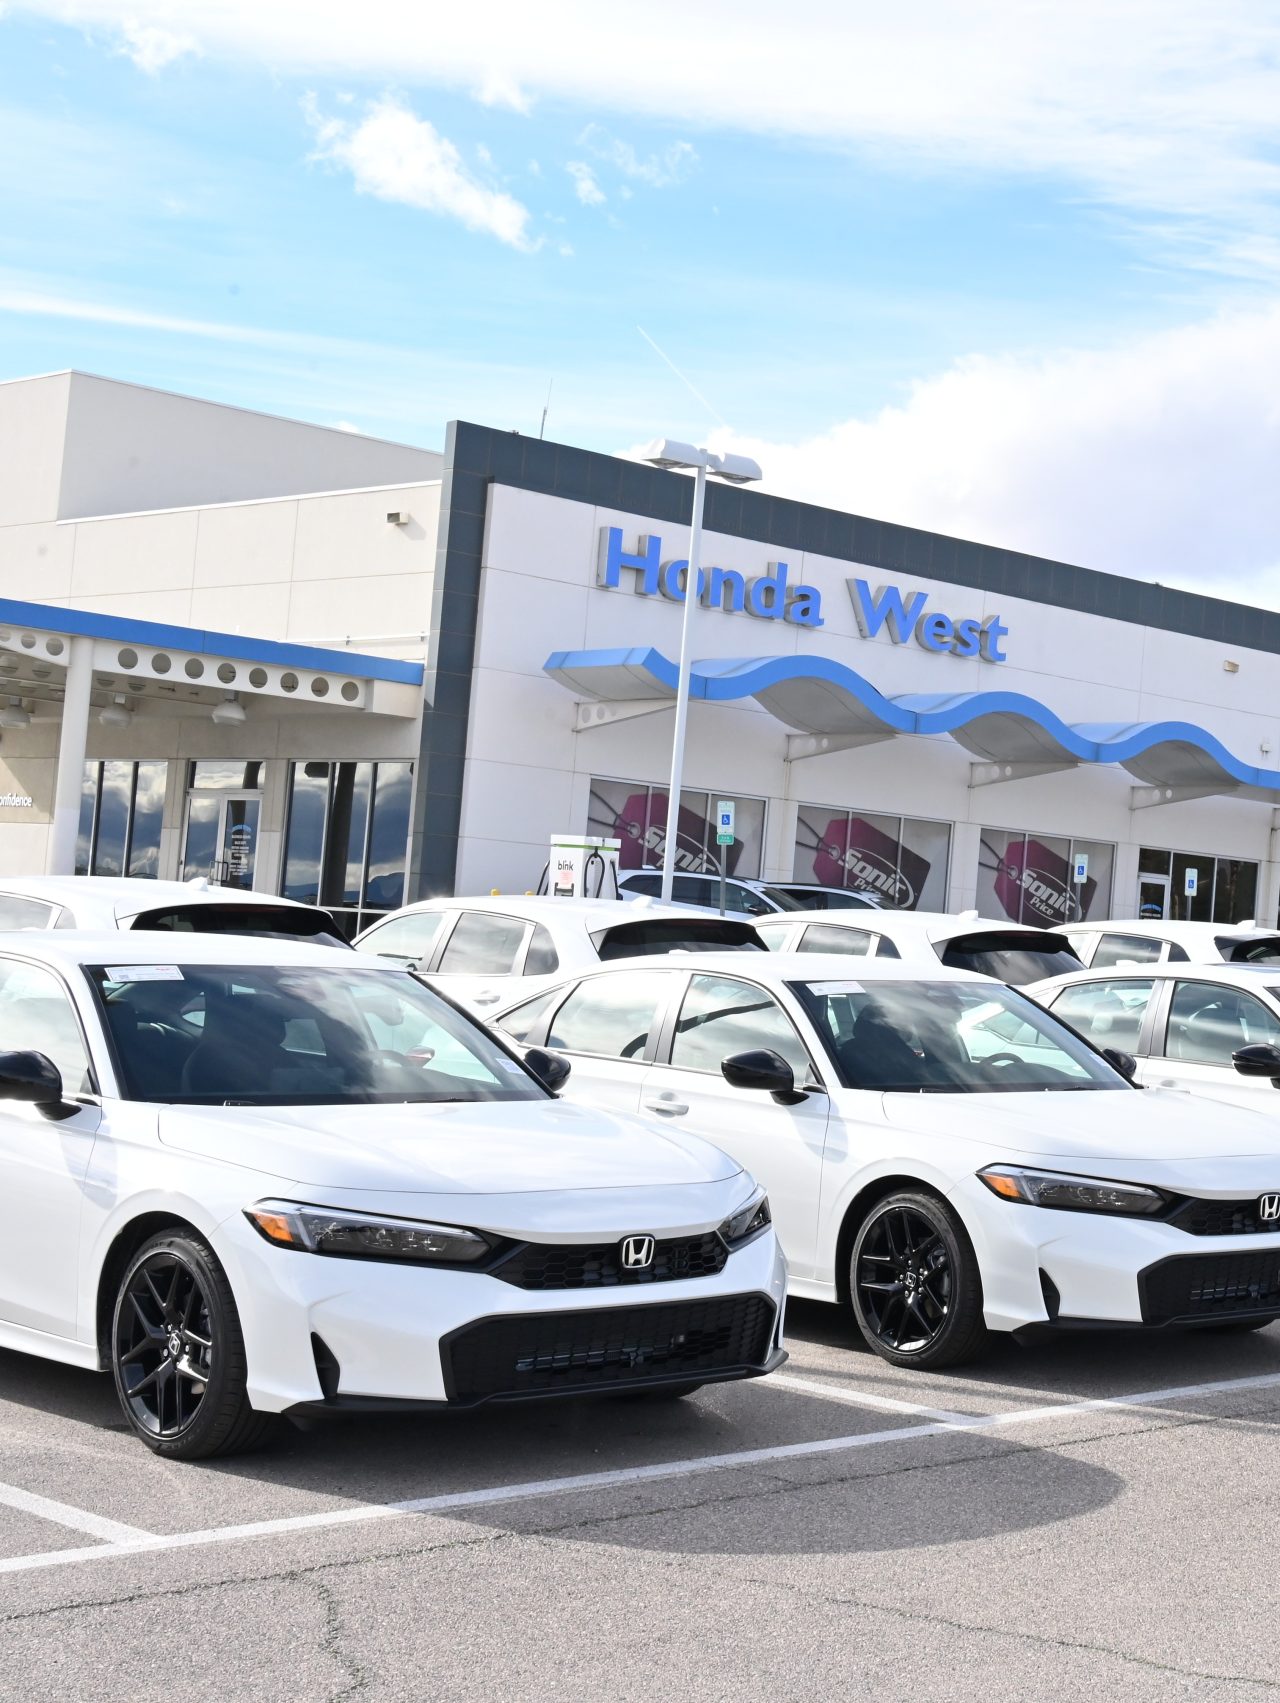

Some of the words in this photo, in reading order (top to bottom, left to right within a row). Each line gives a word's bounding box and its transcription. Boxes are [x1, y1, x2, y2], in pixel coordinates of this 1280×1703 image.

[598, 526, 825, 628] Honda
[846, 577, 1009, 662] West
[557, 860, 574, 871] blink
[838, 848, 907, 898] Sonic
[1016, 869, 1076, 914] Sonic
[1030, 896, 1054, 916] Price
